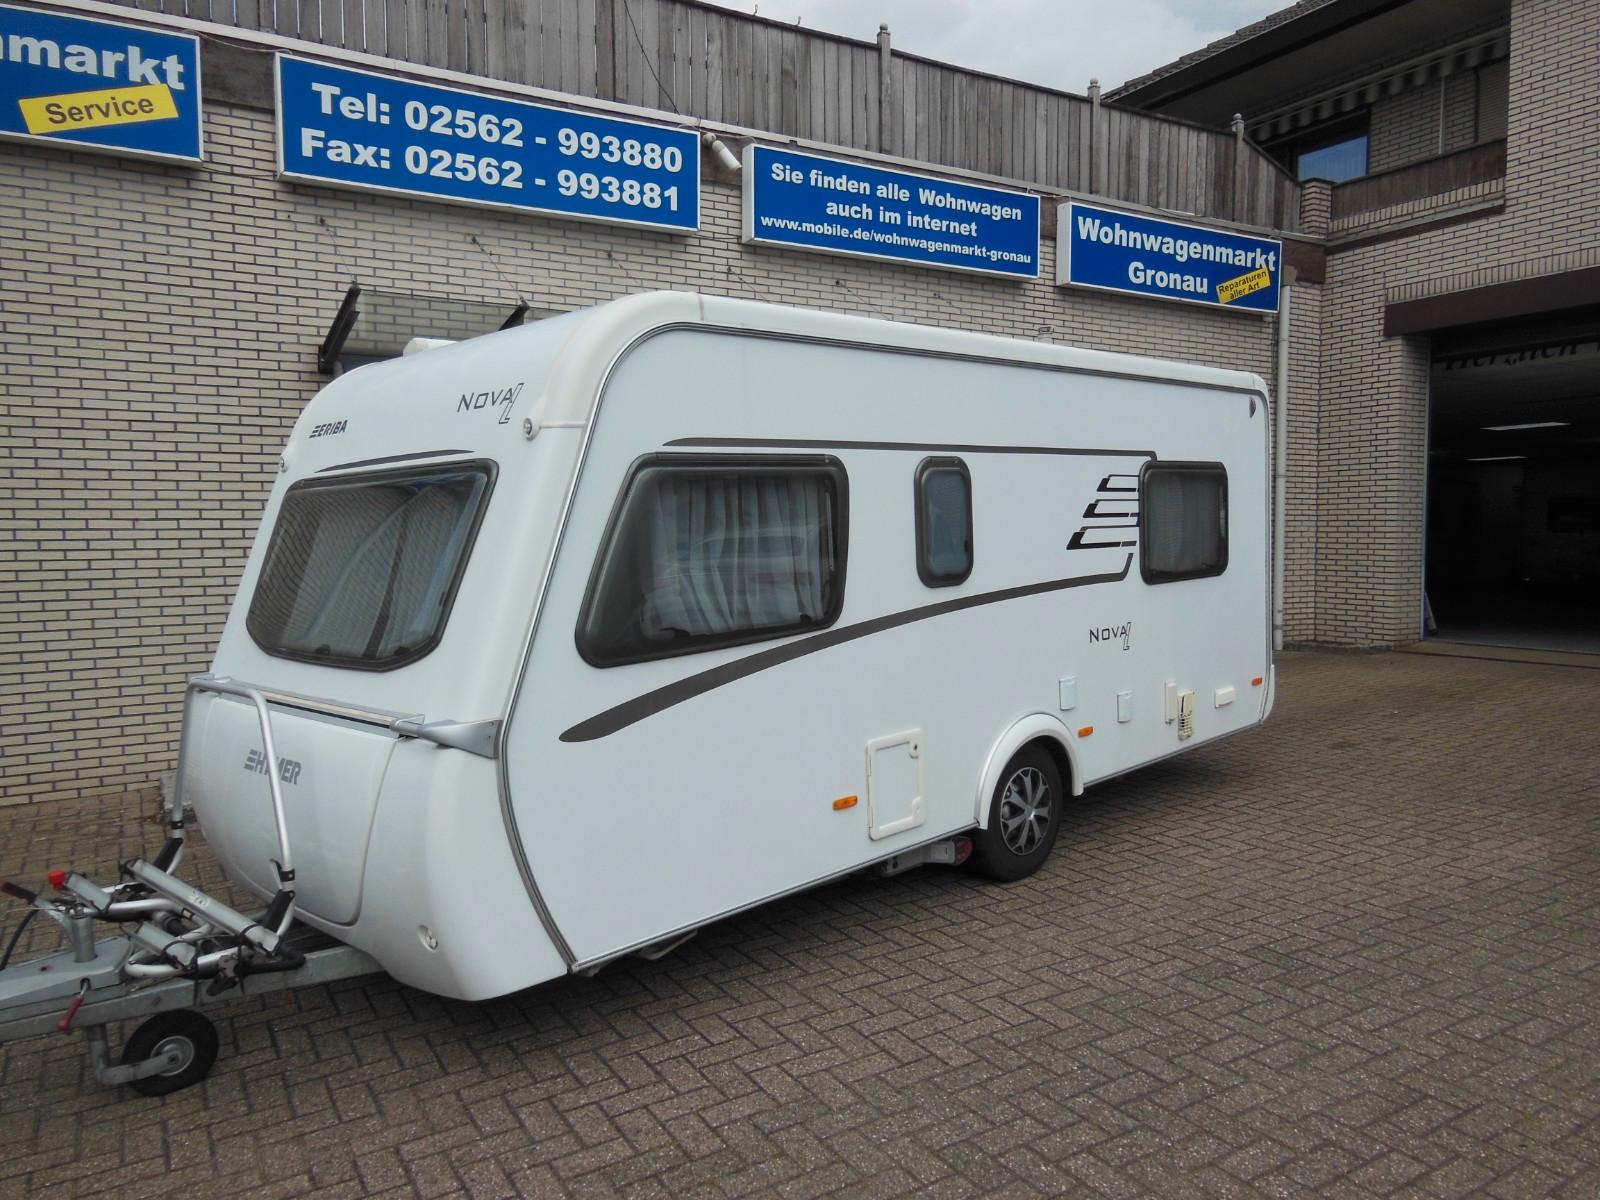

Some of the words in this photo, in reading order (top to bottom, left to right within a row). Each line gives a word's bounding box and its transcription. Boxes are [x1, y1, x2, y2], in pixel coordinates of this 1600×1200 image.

[0, 34, 184, 90] markt
[45, 97, 154, 124] Service
[311, 82, 390, 124] Tel:
[405, 100, 523, 147] 02562
[558, 128, 683, 173] 993880
[301, 127, 391, 169] Fax:
[404, 145, 523, 189] 02562
[557, 169, 678, 212] 993881
[771, 162, 804, 184] Sie
[809, 169, 871, 196] finden
[876, 182, 910, 202] alle
[918, 187, 1022, 221] Wohnwagen
[760, 215, 1031, 264] www.mobile.de/wohnwagenmarkt-gronau
[826, 201, 873, 220] auch
[879, 206, 901, 225] im
[907, 210, 978, 237] internet
[1077, 215, 1276, 272] Wohnwagenmarkt
[1128, 261, 1208, 294] Gronau
[1218, 270, 1267, 295] Reparaturen
[1230, 287, 1246, 300] aller
[1248, 281, 1260, 293] Art
[311, 420, 348, 438] ERIBA
